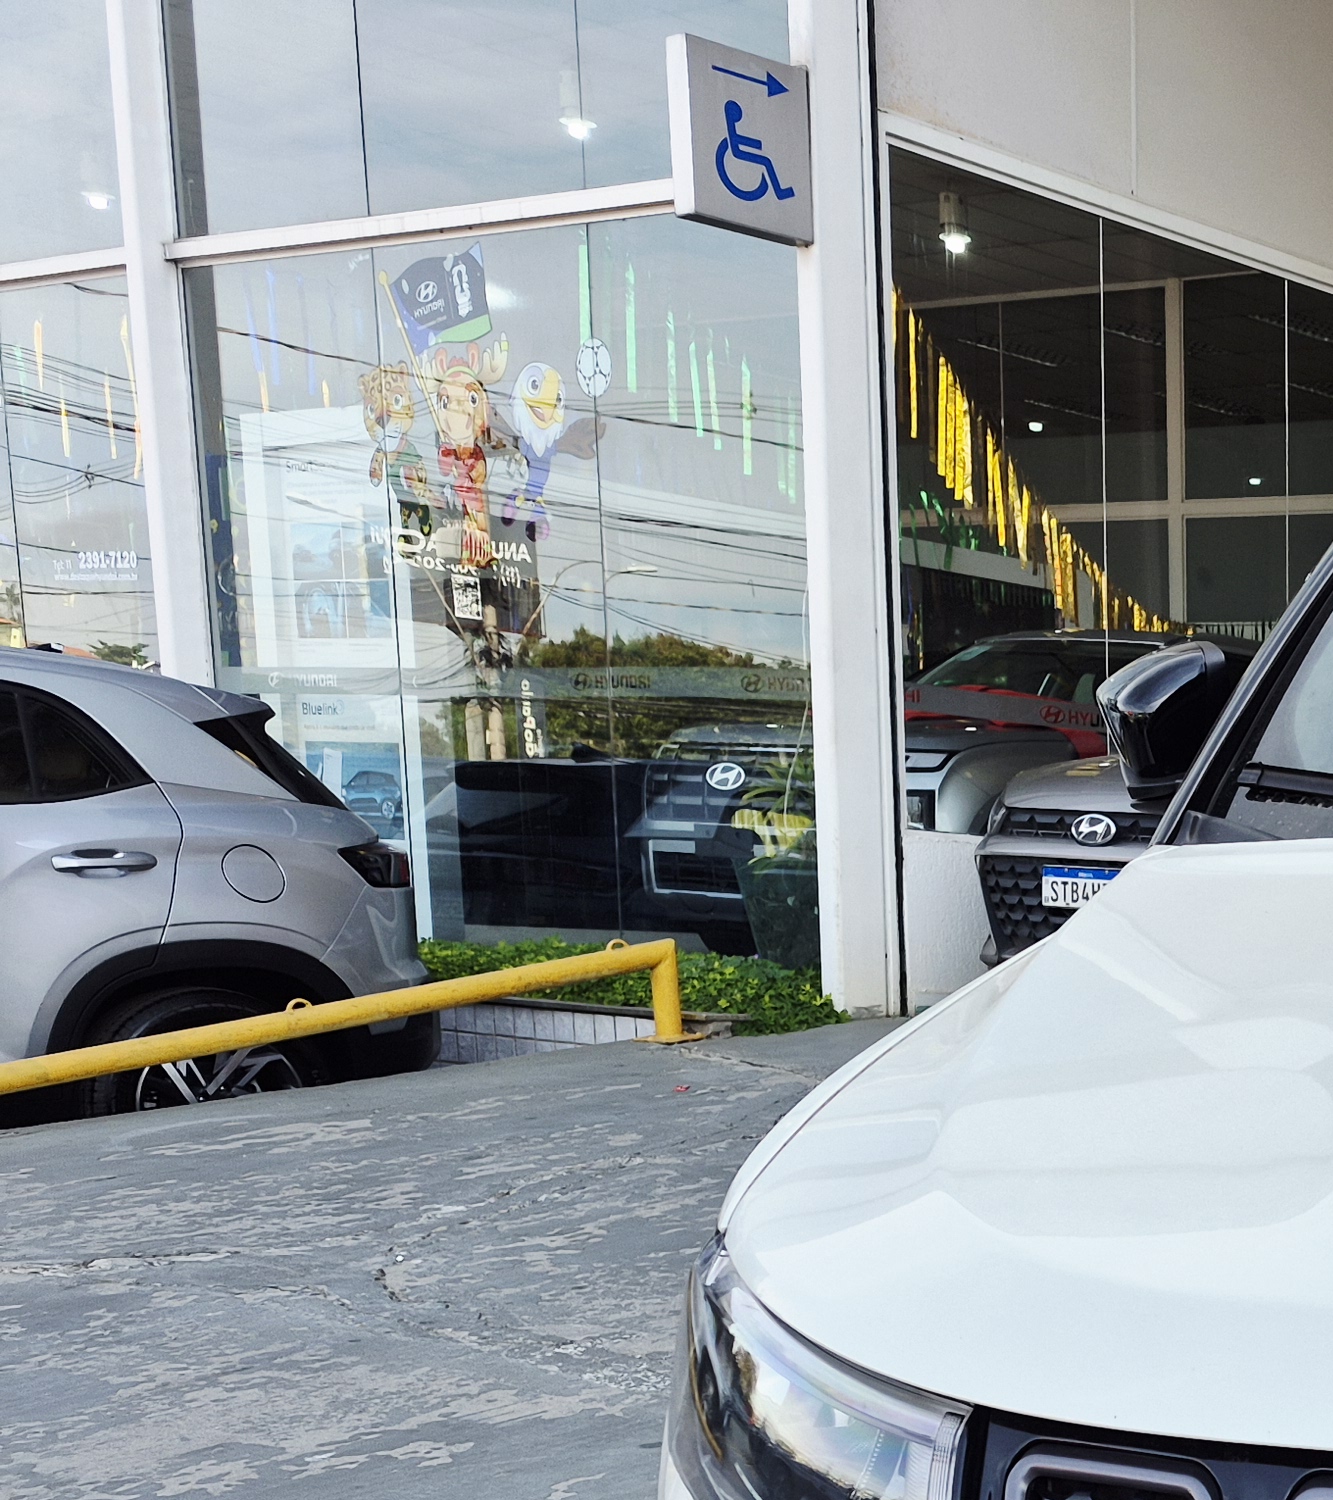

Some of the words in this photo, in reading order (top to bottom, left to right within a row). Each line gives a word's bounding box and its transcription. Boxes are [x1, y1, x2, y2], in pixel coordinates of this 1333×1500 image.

[78, 550, 138, 569] 2391-7120
[302, 702, 339, 716] Bluelink
[1050, 880, 1108, 903] STB4H
